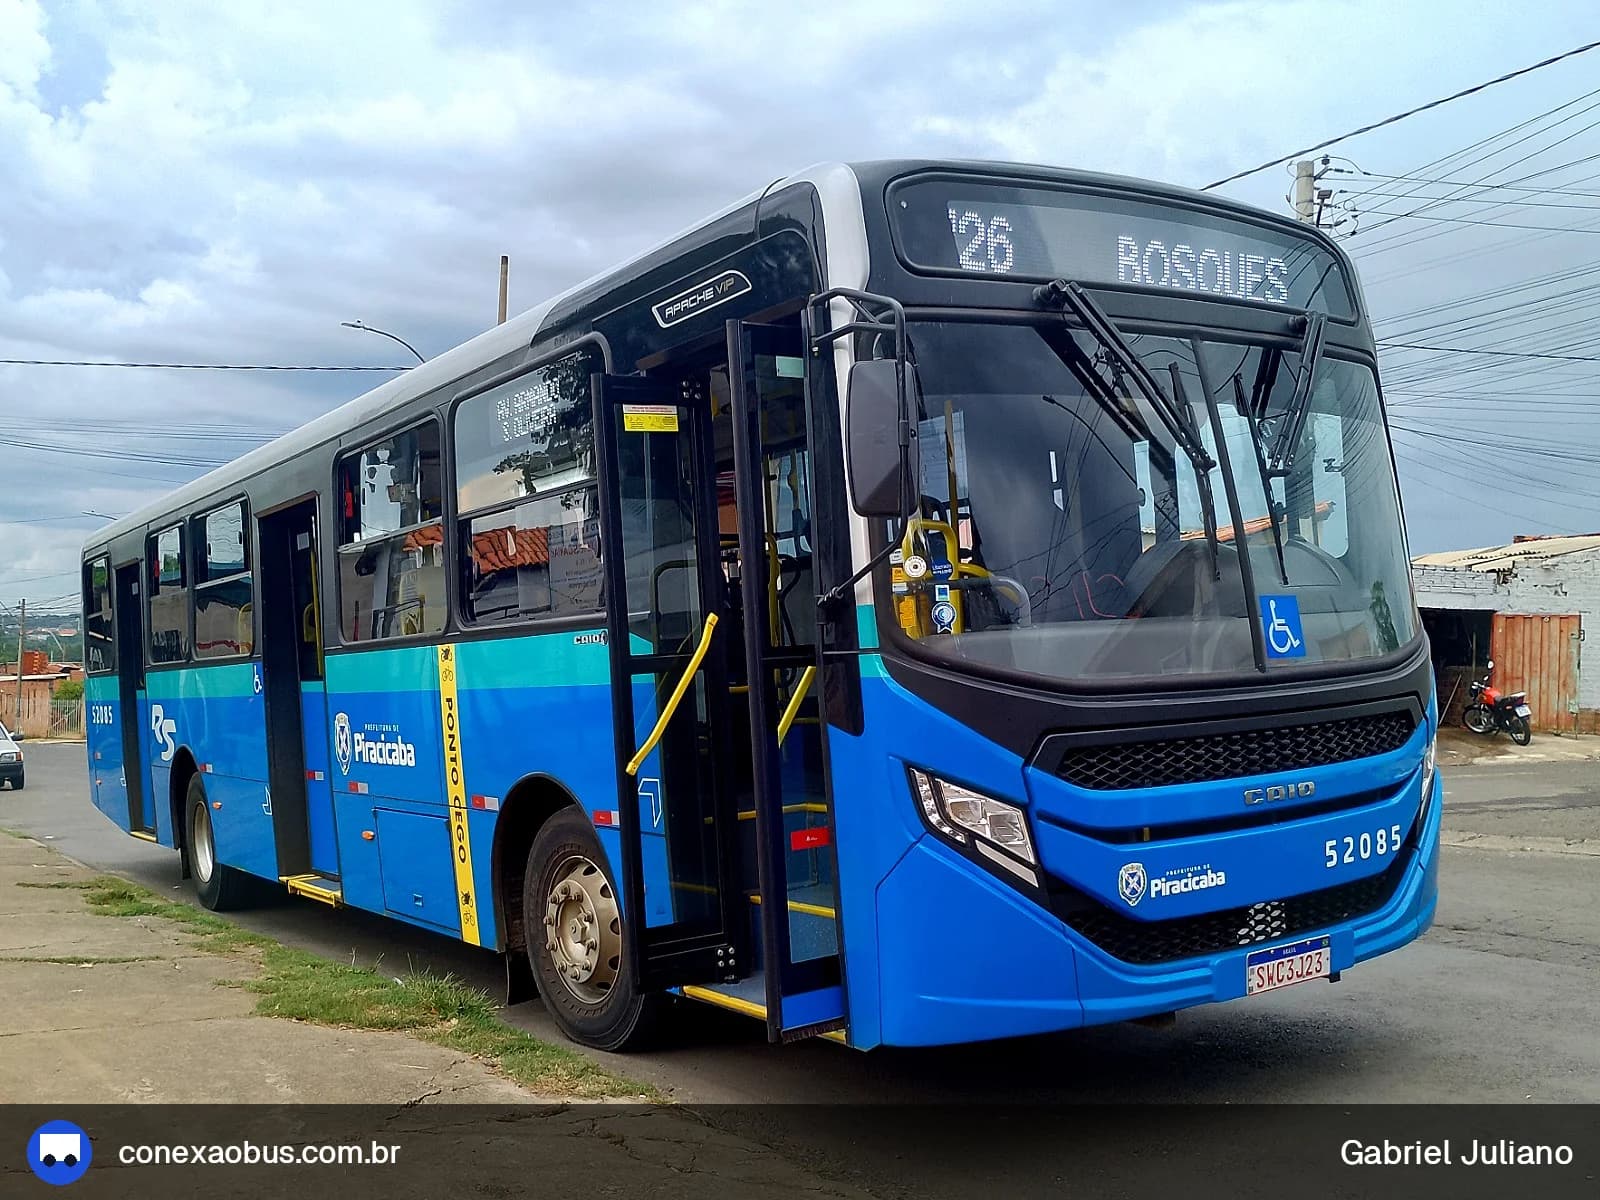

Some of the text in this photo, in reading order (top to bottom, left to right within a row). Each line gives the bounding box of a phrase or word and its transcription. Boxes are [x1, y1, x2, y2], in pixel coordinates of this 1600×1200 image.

[1117, 235, 1289, 304] BOSQUES
[665, 276, 735, 319] APACHE VIP
[92, 705, 113, 724] 52085
[364, 724, 392, 733] PREFEITURA
[353, 732, 416, 768] Piracicaba
[445, 697, 467, 866] PONTO CEGO
[1243, 780, 1316, 806] CAIO
[1324, 824, 1402, 869] 52085
[1150, 869, 1226, 899] Piracicaba
[1165, 865, 1201, 877] PREFEITURA
[1256, 951, 1323, 989] SWC3J23
